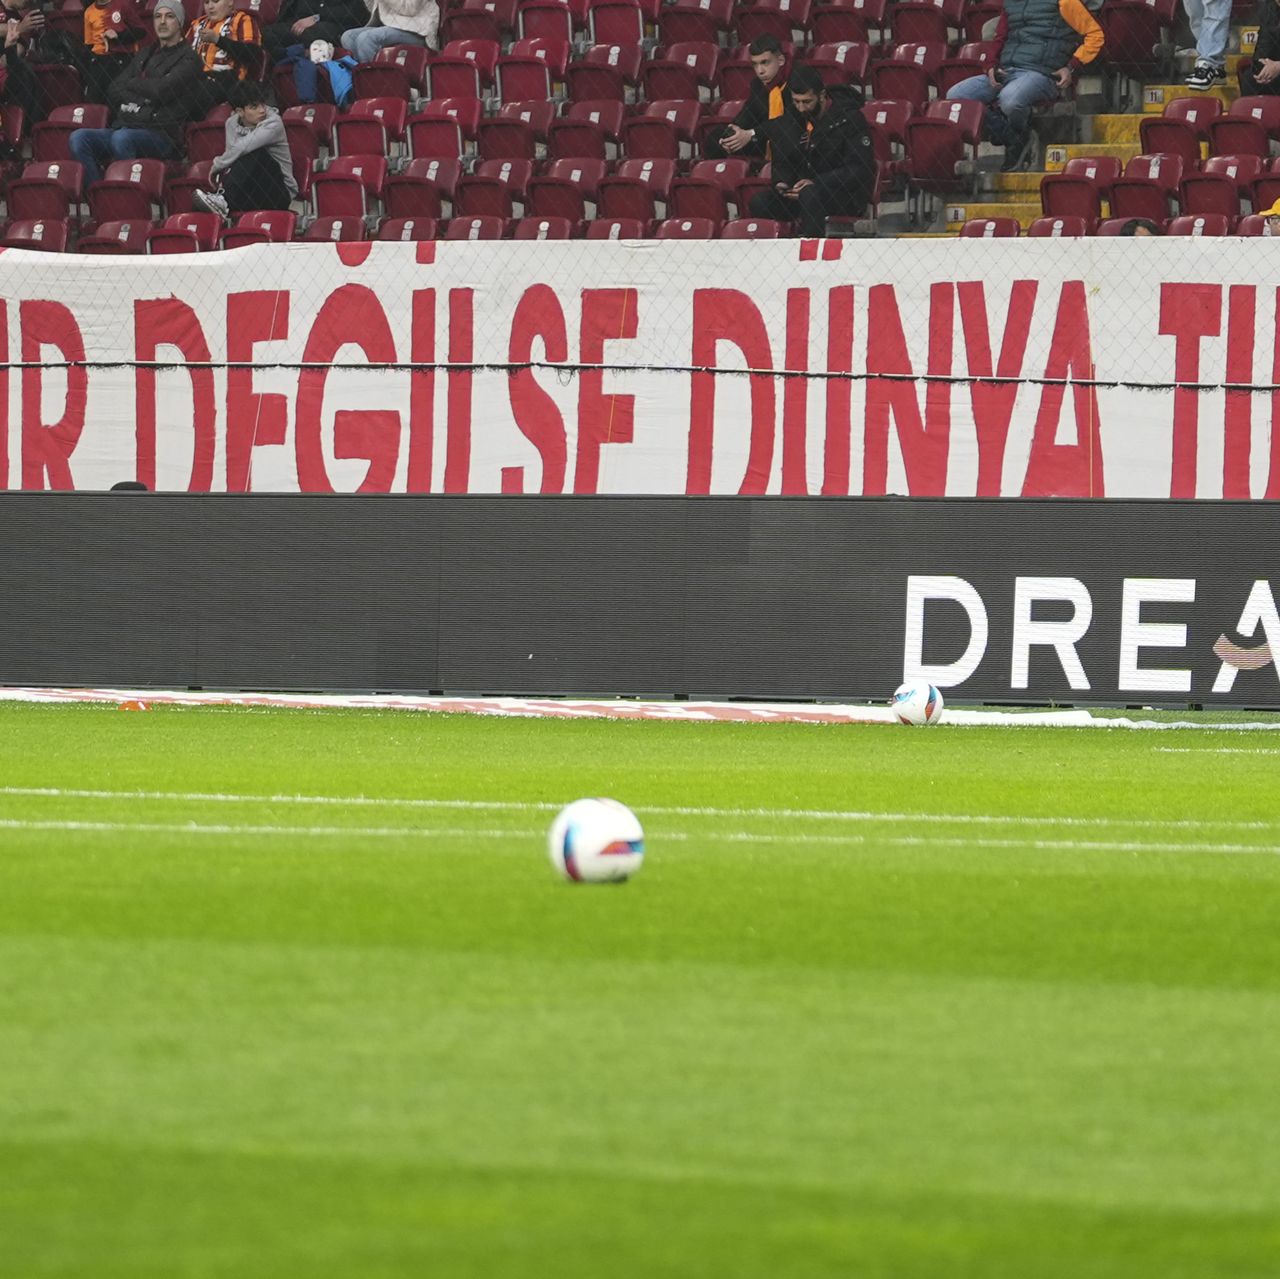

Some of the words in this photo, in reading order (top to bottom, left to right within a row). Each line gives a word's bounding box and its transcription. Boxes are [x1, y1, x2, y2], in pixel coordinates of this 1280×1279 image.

[1246, 32, 1255, 43] 12
[1150, 90, 1158, 101] 11
[1052, 151, 1061, 161] 10
[134, 240, 638, 493] DEĞİLSE
[687, 238, 1104, 497] DÜNYA
